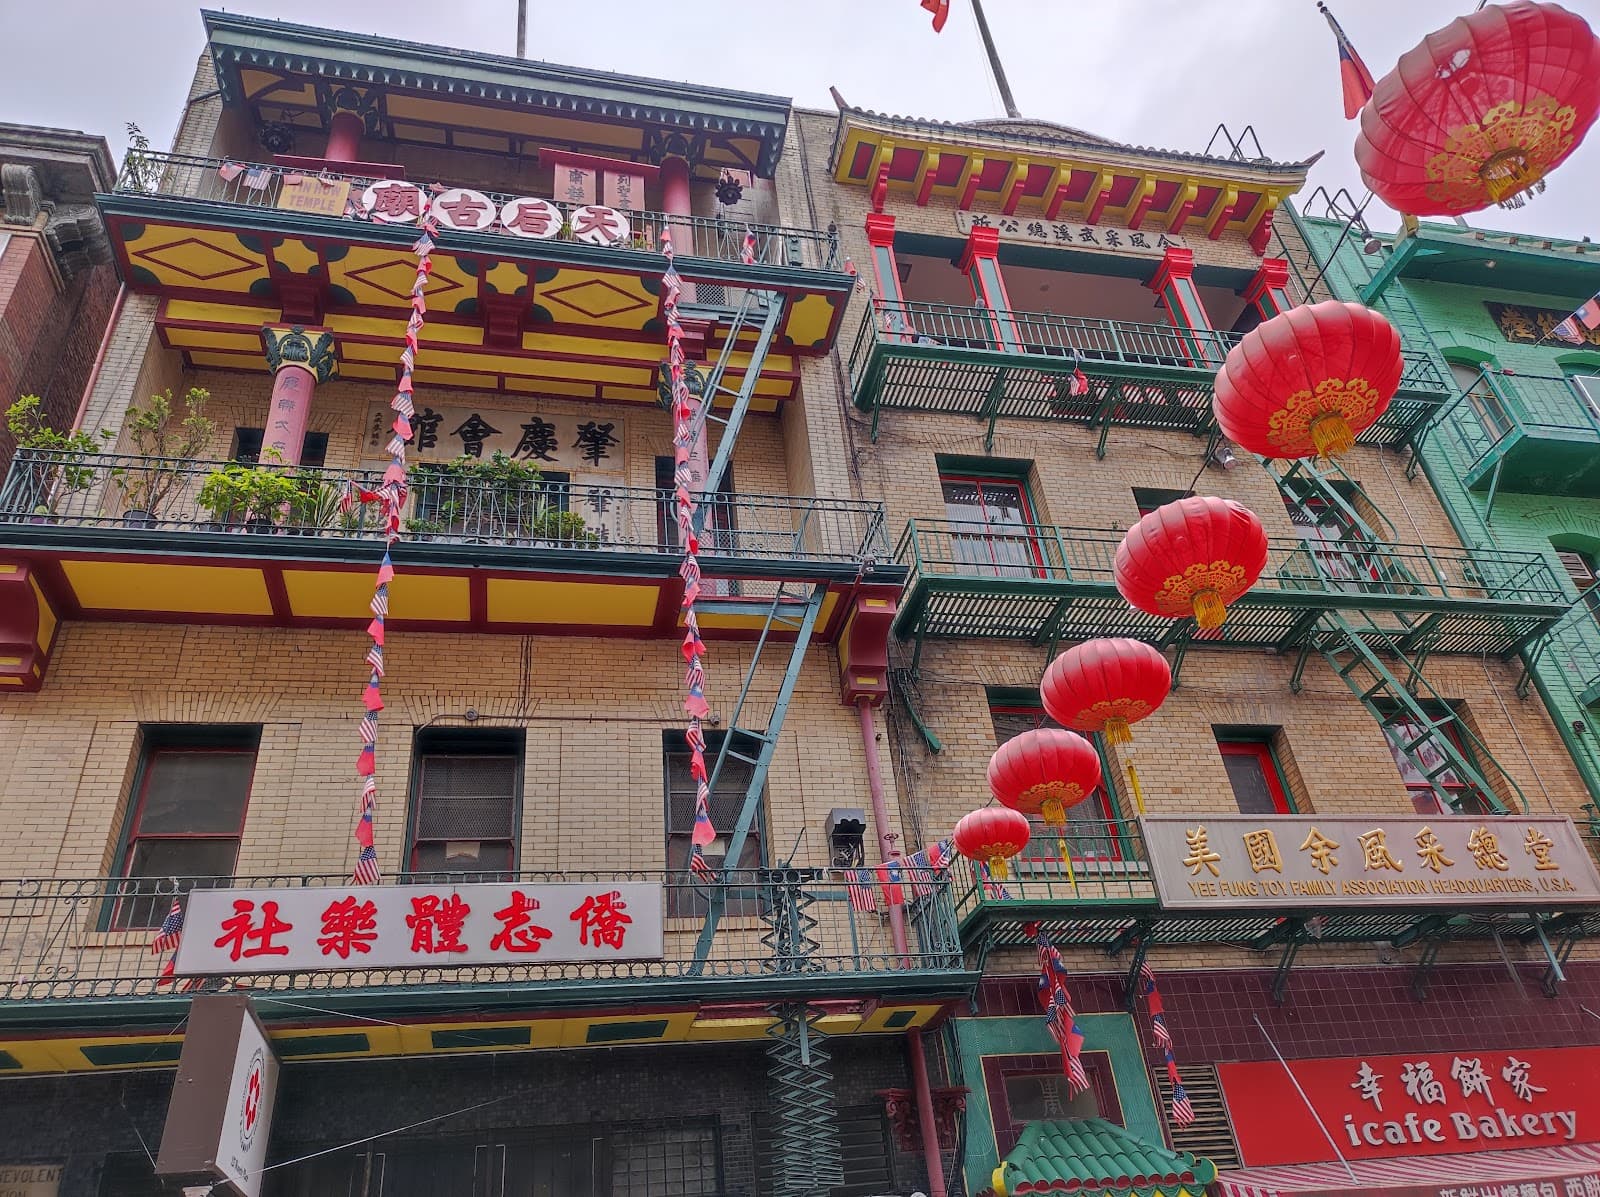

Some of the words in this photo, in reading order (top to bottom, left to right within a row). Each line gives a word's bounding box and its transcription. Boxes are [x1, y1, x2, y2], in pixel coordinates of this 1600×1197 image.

[289, 195, 336, 211] TEMPLE
[1182, 824, 1560, 877] 美國余風采總堂
[1187, 880, 1217, 896] YEE
[1218, 880, 1259, 896] FUNG
[1259, 879, 1289, 896] TOY
[1289, 879, 1338, 895] FAMILY
[1342, 879, 1428, 895] ASSOCIATION
[1429, 878, 1540, 894] HEADQUARTERS,
[1351, 1056, 1547, 1112] 幸福餅家
[1344, 1112, 1447, 1146] icafe
[1450, 1108, 1576, 1140] Bakery
